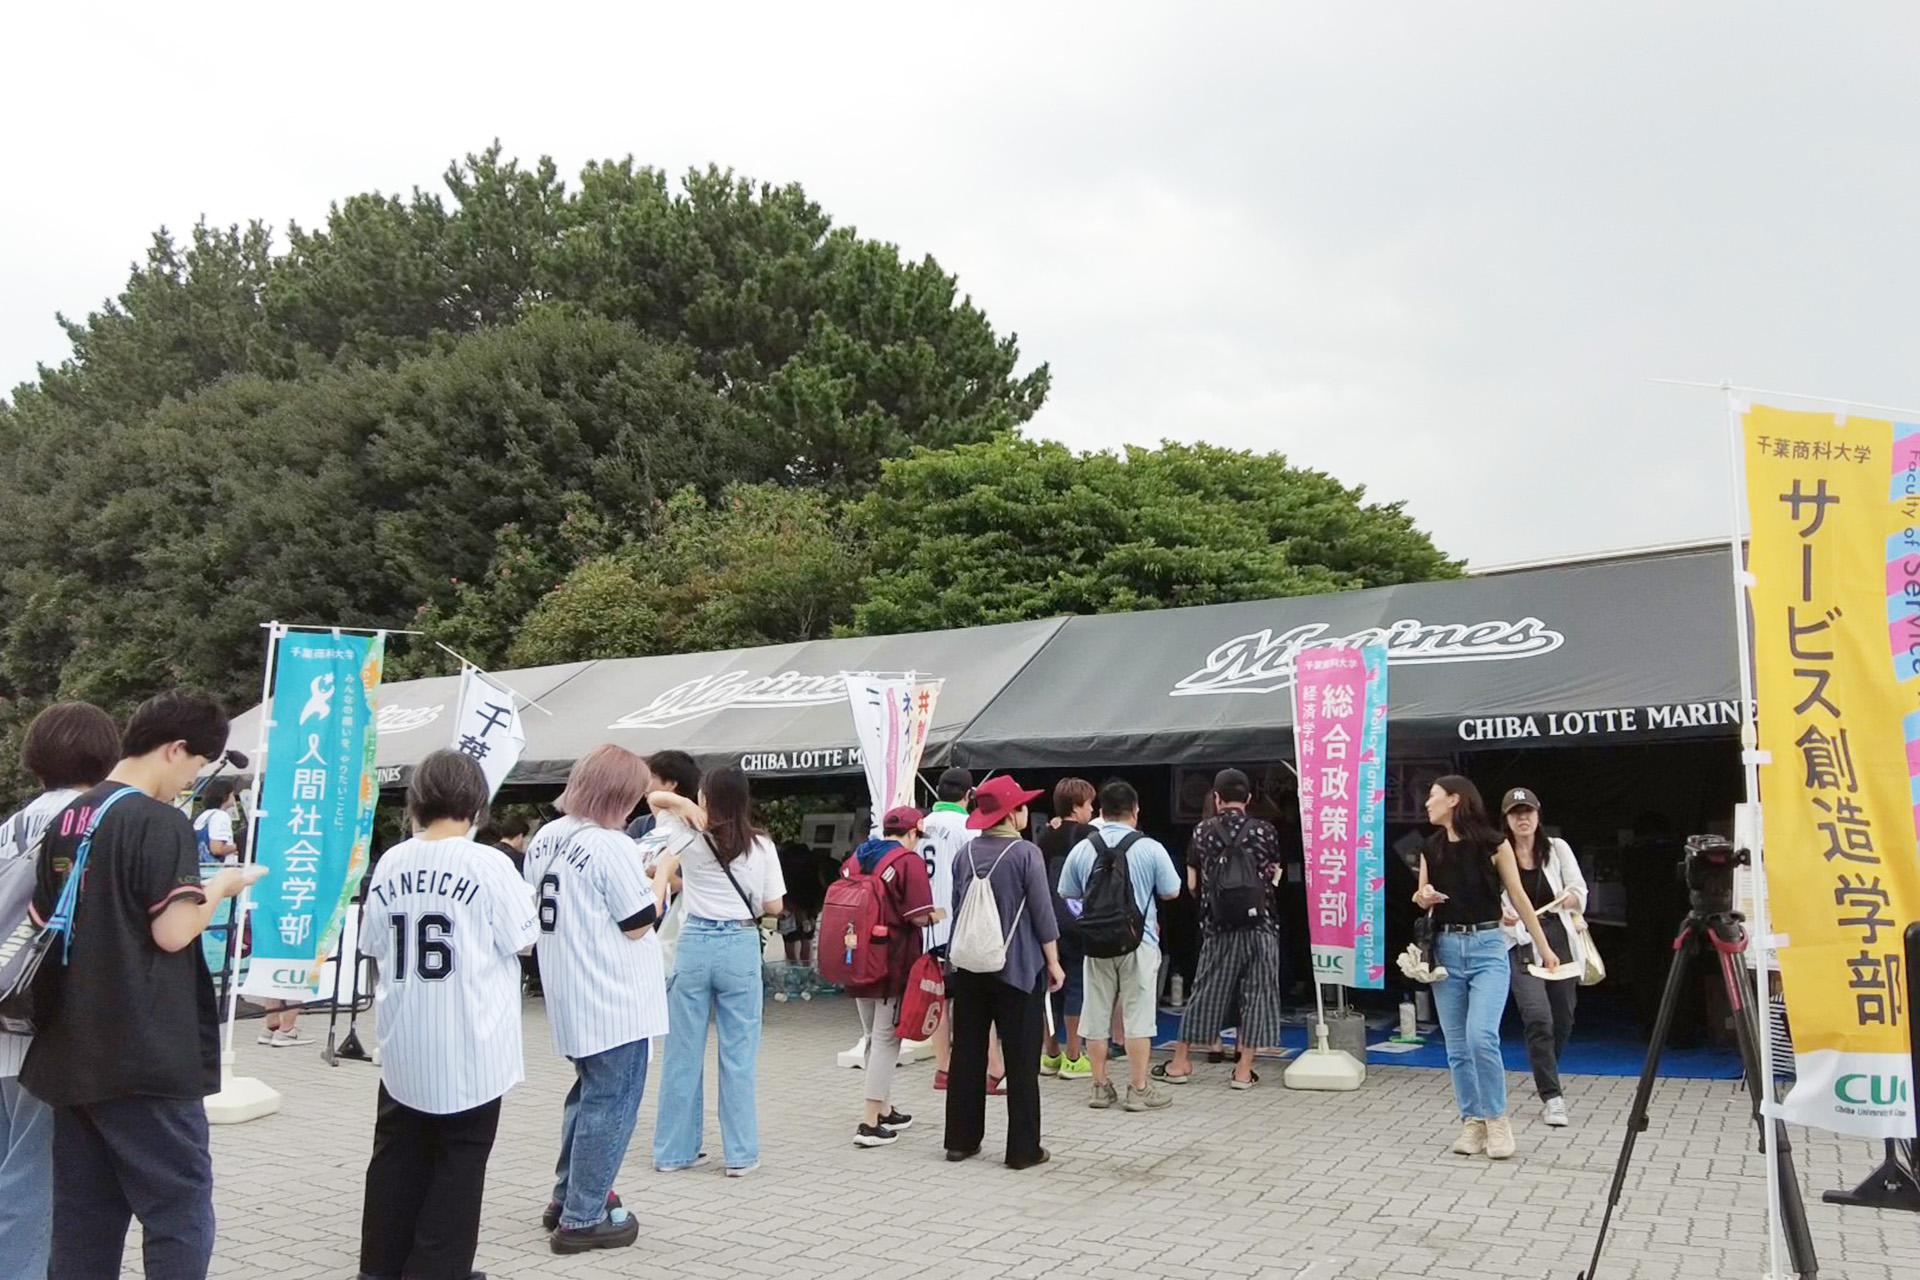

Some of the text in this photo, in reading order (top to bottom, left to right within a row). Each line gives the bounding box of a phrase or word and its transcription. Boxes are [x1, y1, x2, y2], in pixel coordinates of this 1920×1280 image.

[1757, 435, 1871, 464] 千葉商科大学
[1904, 527, 1920, 547] of
[607, 670, 848, 729] Marine
[1457, 700, 1758, 741] CHIBA LOTTE MARINE
[1366, 707, 1383, 751] Policy
[740, 753, 788, 771] CHIBA
[792, 749, 843, 769] LOTTE
[1779, 478, 1903, 1026] サービス創造学部
[1319, 684, 1355, 928] 総合政策学部
[1362, 757, 1381, 824] Planning
[279, 734, 328, 945] 人間社会学部
[1364, 830, 1378, 861] and
[371, 870, 479, 907] TANEICHI
[538, 871, 560, 934] 6
[1361, 866, 1379, 974] Management
[388, 911, 455, 983] 16
[272, 969, 308, 985] CU
[922, 1002, 940, 1036] 6
[1834, 1073, 1906, 1105] CU
